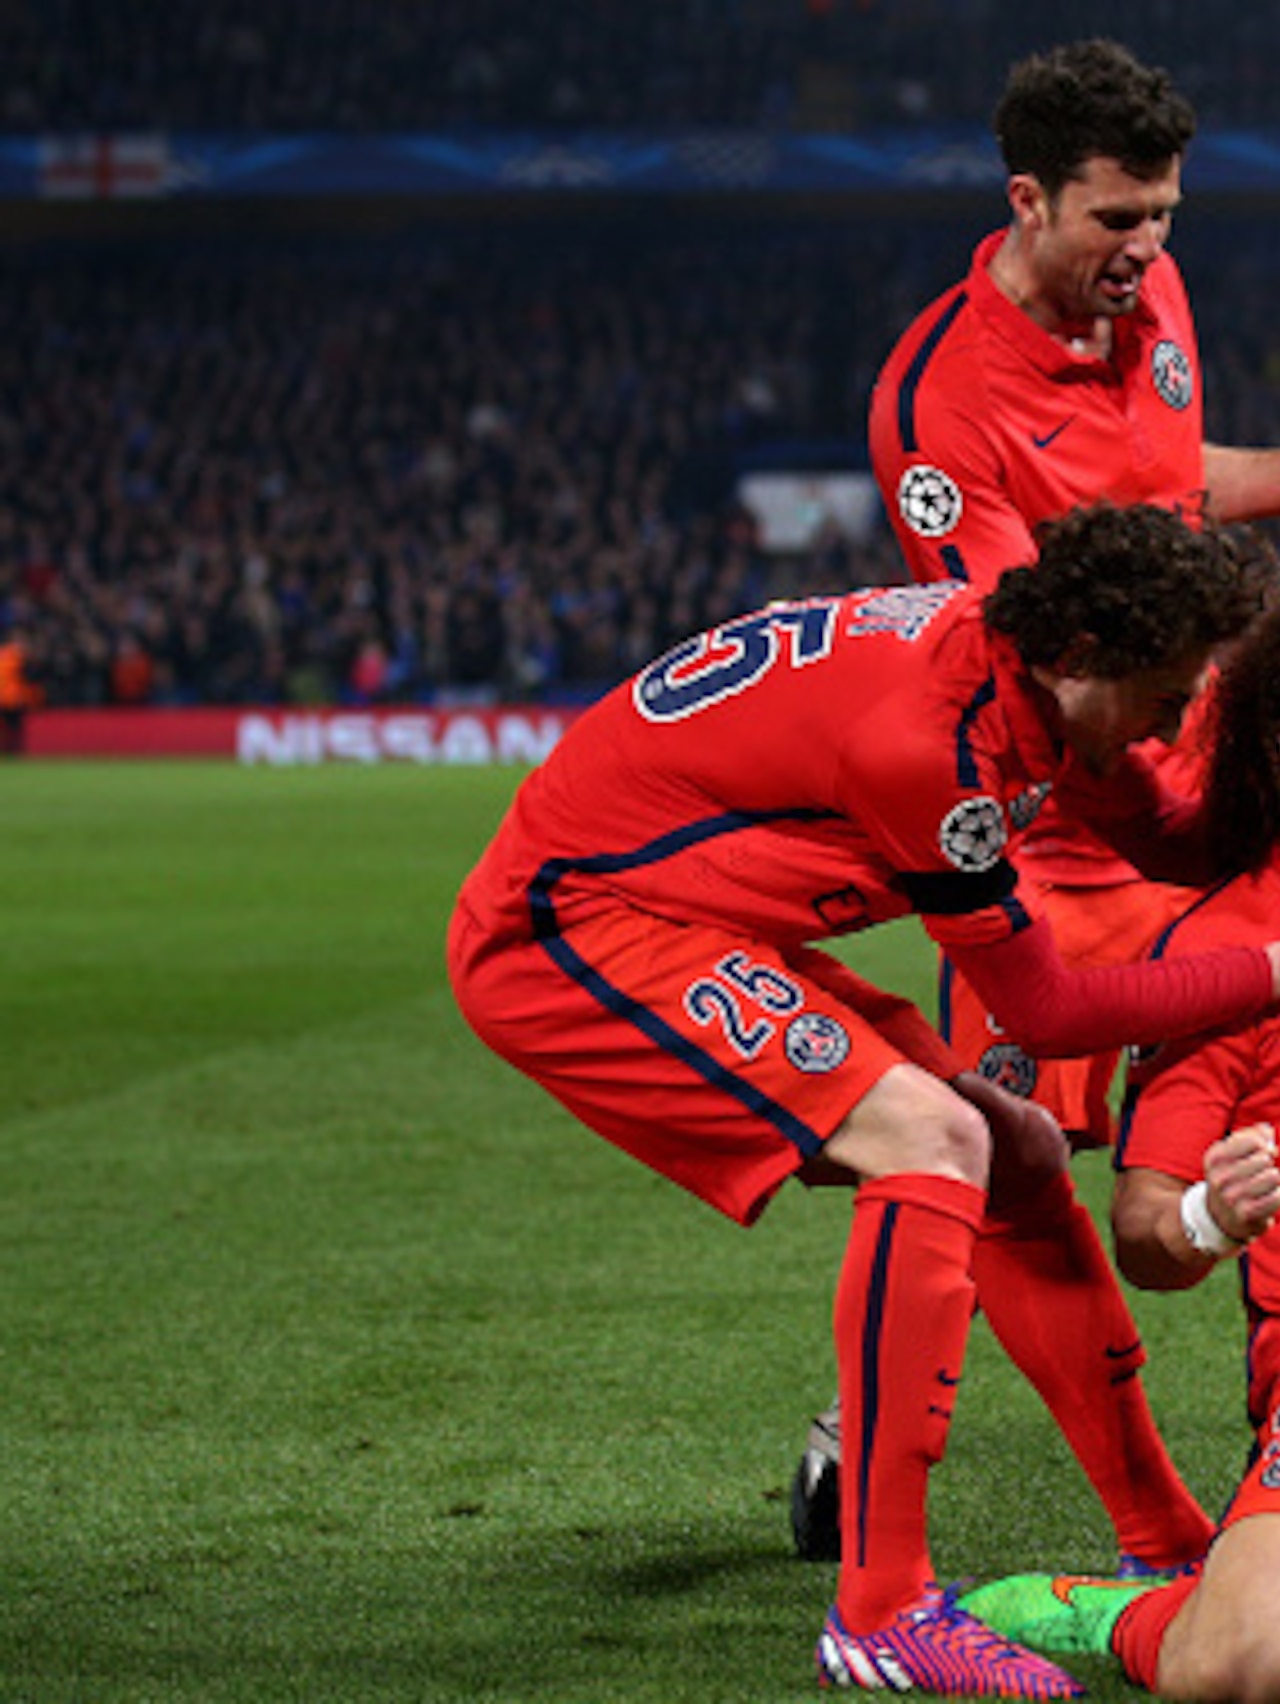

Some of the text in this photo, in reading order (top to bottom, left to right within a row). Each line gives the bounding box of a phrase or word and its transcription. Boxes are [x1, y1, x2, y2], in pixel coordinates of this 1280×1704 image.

[632, 599, 840, 722] 5
[237, 713, 563, 765] NISSAN
[682, 950, 804, 1063] 25
